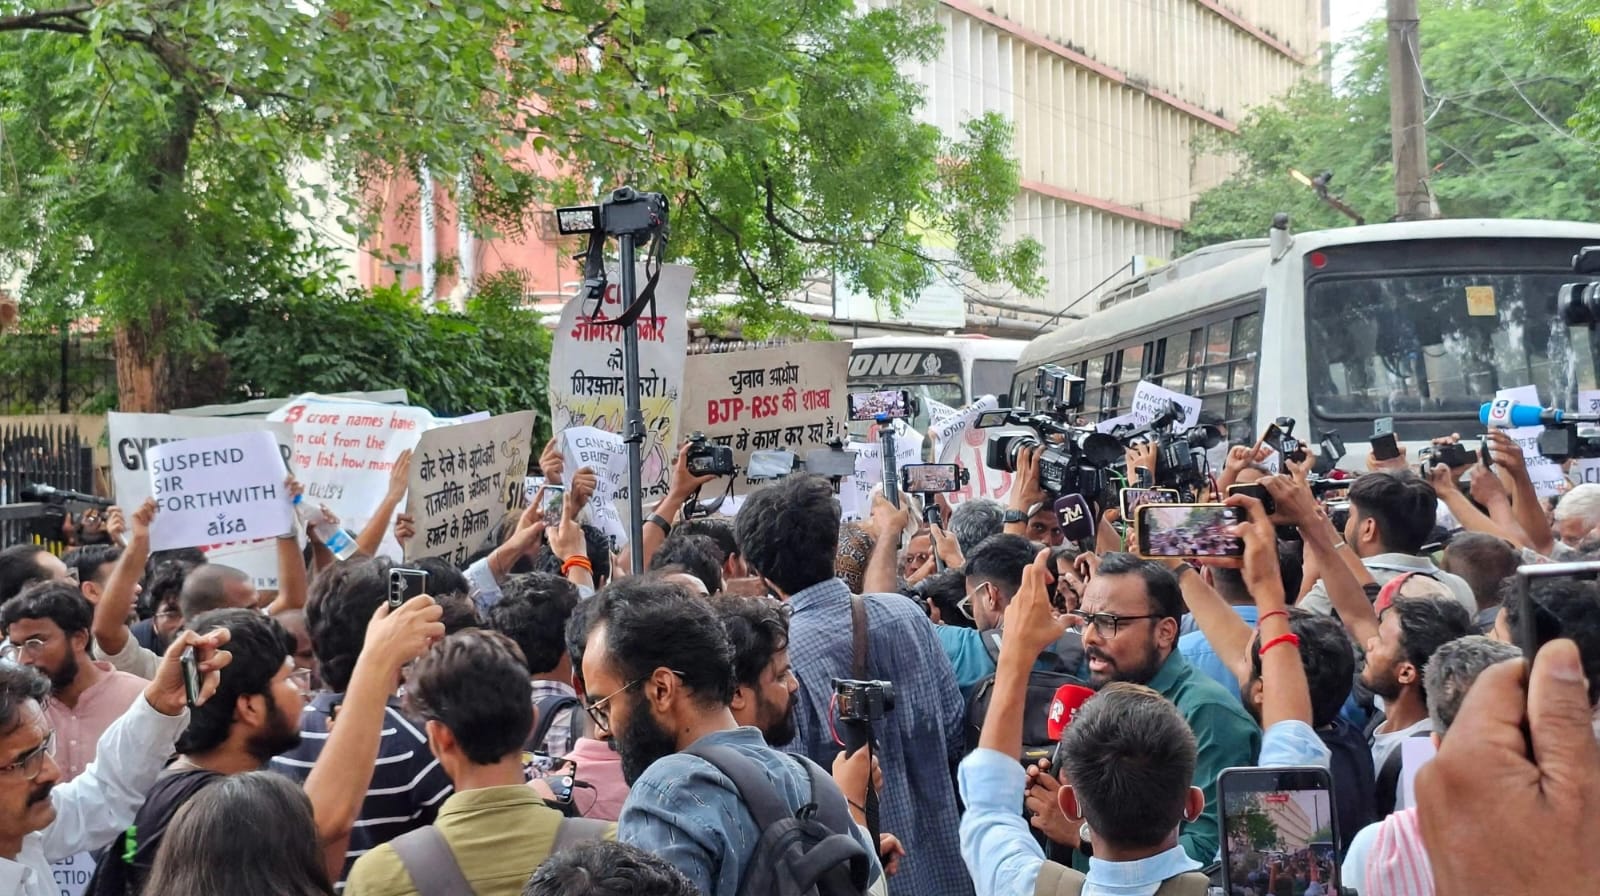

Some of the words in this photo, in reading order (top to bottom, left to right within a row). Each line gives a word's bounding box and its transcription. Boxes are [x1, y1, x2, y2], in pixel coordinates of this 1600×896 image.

[848, 353, 922, 377] ONU
[729, 368, 765, 394] चुनाव
[708, 394, 779, 425] BJP-RSS
[782, 386, 797, 412] की
[307, 412, 340, 425] crore
[346, 415, 384, 427] names
[308, 433, 326, 445] cut
[334, 432, 361, 447] from
[366, 435, 385, 450] the
[752, 429, 781, 449] काम
[785, 425, 804, 445] कर
[152, 448, 244, 475] SUSPEND
[342, 453, 364, 468] how
[155, 476, 183, 494] SIR
[156, 484, 276, 513] FORTHWITH
